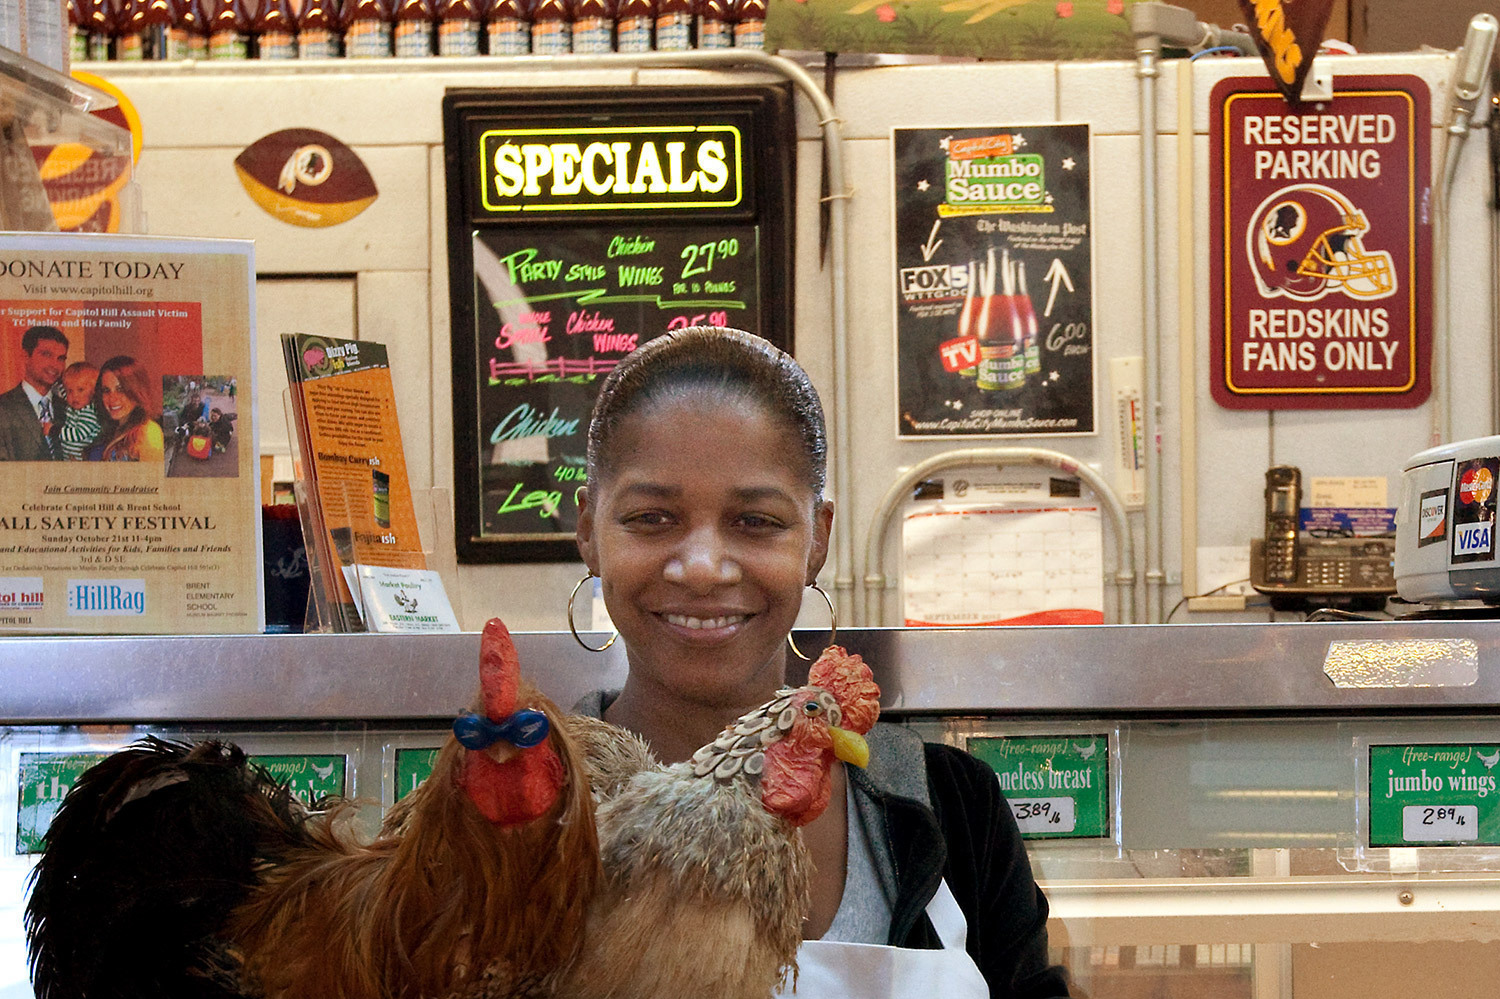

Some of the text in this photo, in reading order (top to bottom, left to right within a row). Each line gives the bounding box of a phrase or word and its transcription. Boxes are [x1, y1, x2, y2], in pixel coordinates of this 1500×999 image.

[1243, 114, 1396, 145] RESERVED
[494, 140, 730, 197] SPECIALS
[948, 159, 1041, 178] Mumbo
[1254, 149, 1381, 180] PARKING
[948, 178, 1041, 201] Sauce
[607, 235, 656, 258] Chicken
[99, 260, 185, 280] TODAY
[500, 248, 665, 287] PARTY STYLE WINGS
[904, 265, 969, 291] FOX 5
[23, 284, 154, 297] Visit www.capitolhill.org
[8, 307, 189, 318] Support for Capitol Hill Assault Victim
[12, 318, 132, 329] TC Maslin and His Family
[1249, 308, 1390, 339] REDSKINS
[566, 309, 640, 353] Chicken WINGS
[943, 339, 977, 368] TV
[1242, 340, 1399, 372] FANS ONLY
[490, 402, 580, 445] Chicken
[553, 465, 575, 482] 40
[43, 485, 159, 495] Join Community Fundraiser
[497, 482, 563, 518] Leg
[22, 502, 181, 513] Celebrate Capitol Hill & Brent School
[41, 516, 217, 530] SAFETY FESTIVAL
[18, 545, 68, 553] Educational
[70, 545, 106, 553] Activities
[107, 545, 120, 554] for
[122, 545, 143, 555] Kids,
[146, 545, 181, 553] Families
[183, 545, 199, 553] and
[201, 545, 232, 553] Friends
[41, 535, 162, 545] Sunday October 21st 11-4pm
[1458, 528, 1489, 550] VISA
[81, 555, 126, 563] 3rd & D SE
[186, 582, 210, 590] BRENT
[186, 592, 235, 600] ELEMENTARY
[21, 592, 44, 603] hill
[76, 585, 145, 614] HillRag
[186, 602, 218, 611] SCHOOL
[1402, 747, 1472, 769] (free-range)
[995, 762, 1092, 791] oneless breast
[1386, 768, 1496, 798] jumbo wings
[1014, 802, 1051, 820] 3.89
